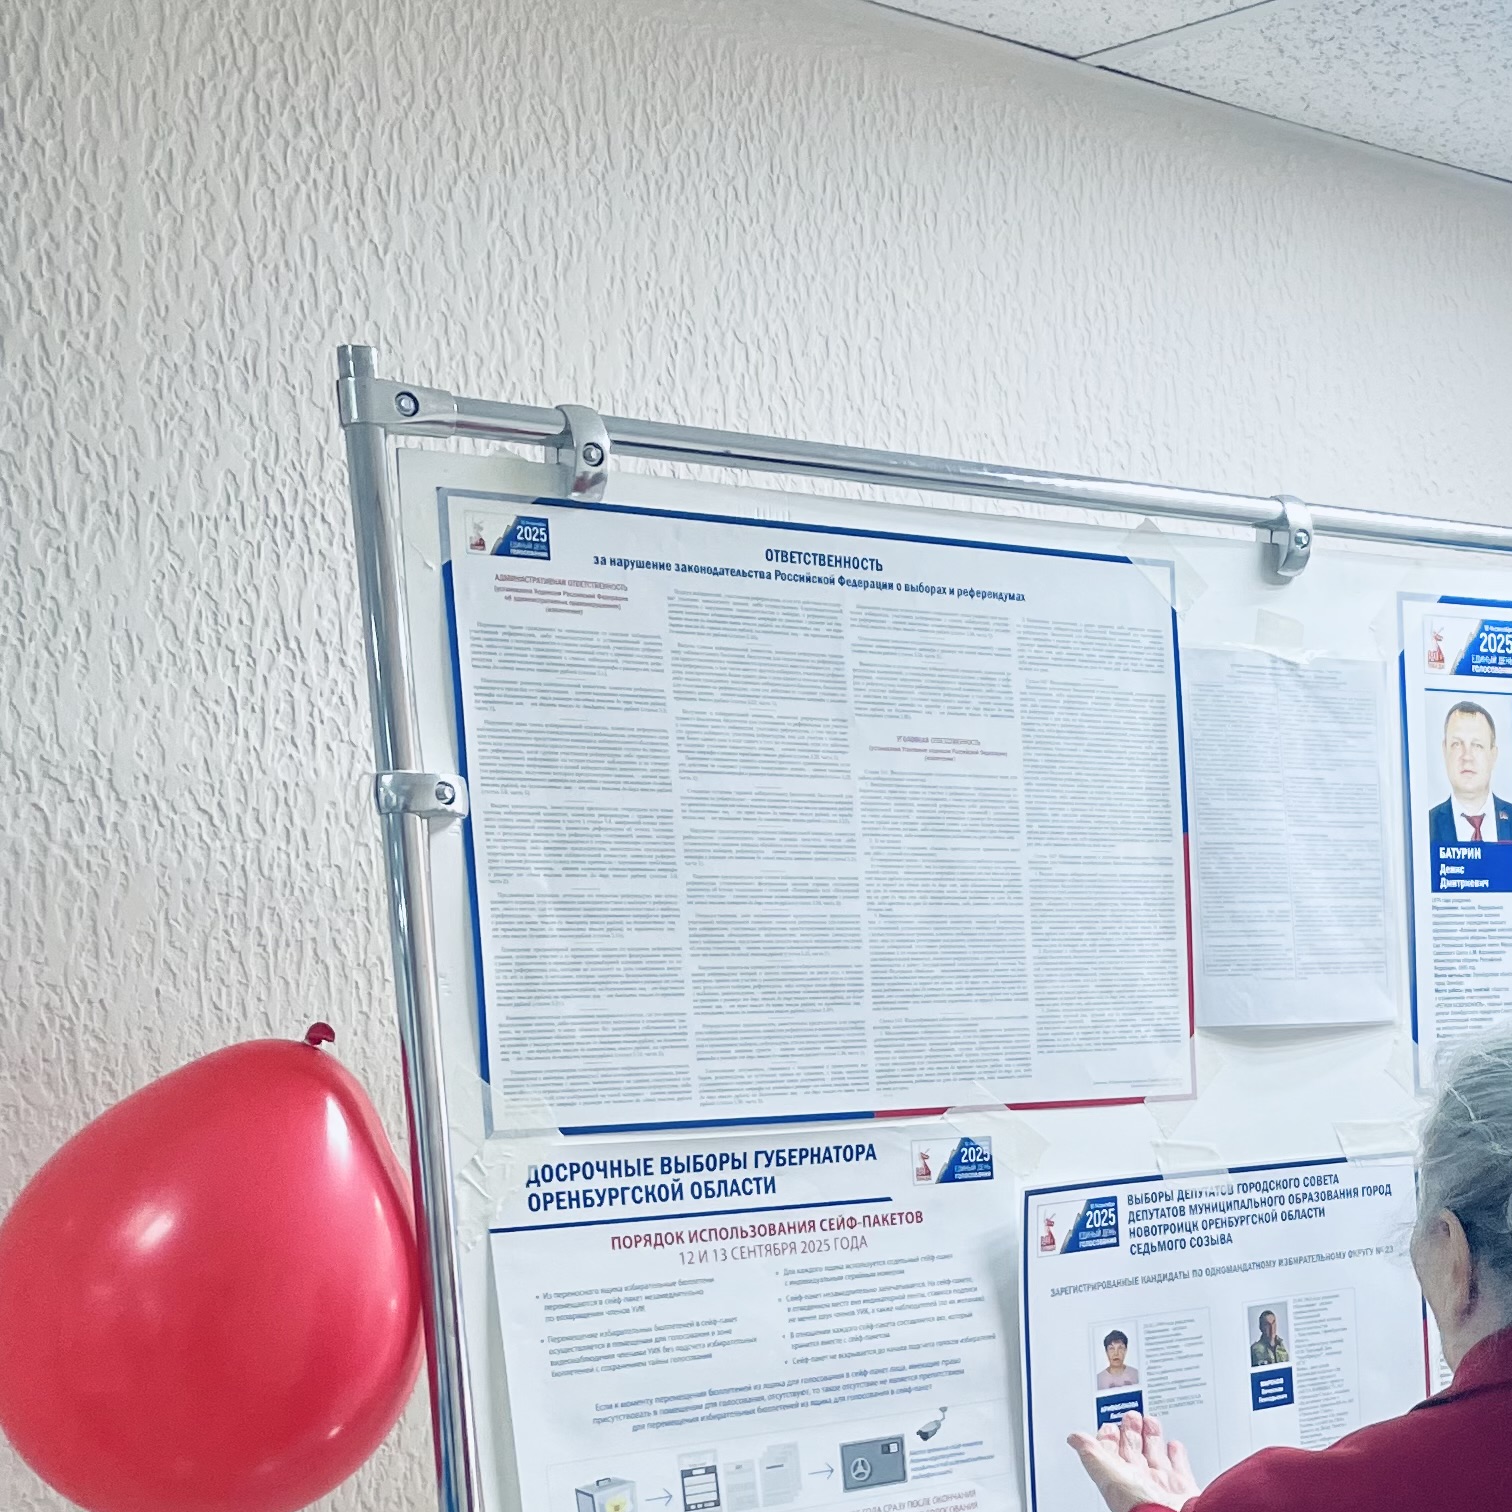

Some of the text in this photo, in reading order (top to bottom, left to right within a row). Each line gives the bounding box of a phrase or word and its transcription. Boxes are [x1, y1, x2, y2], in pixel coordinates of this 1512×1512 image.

[516, 525, 547, 543] 2025
[764, 548, 883, 571] ОТВЕТСТВЕННОСТЬ
[592, 554, 607, 566] за
[608, 557, 672, 571] нарушение
[673, 562, 772, 580] законодательства
[773, 568, 835, 585] Российской
[836, 574, 894, 591] Федерации
[895, 581, 902, 592] о
[903, 581, 947, 596] выборах
[956, 587, 1026, 602] референдумах
[1439, 846, 1482, 860] БАТУРИН
[524, 1143, 877, 1187] ДОСРОЧНЫЕ ВЫБОРЫ ГУБЕРНАТОРА
[960, 1146, 991, 1164] 2025
[526, 1175, 776, 1211] ОРЕНБУРГСКОЙ ОБЛАСТИ
[1126, 1189, 1174, 1206] ВЫБОРЫ
[1235, 1176, 1300, 1194] ГОРОДСКОГО
[1301, 1173, 1340, 1188] СОВЕТА
[1126, 1182, 1392, 1224] ДЕПУТАТОВ МУНИЦИПАЛЬНОГО ОБРАЗОВАНИЯ ГОРОД
[610, 1210, 924, 1250] ПОРЯДОК ИСПОЛЬЗОВАНИЯ СЕЙФ-ПАКЕТОВ
[1085, 1208, 1116, 1229] 2025
[1128, 1206, 1326, 1238] НОВОТРОИЦК ОРЕНБУРГСКОЙ ОБЛАСТИ
[678, 1234, 868, 1265] 12 И 13 СЕНТЯБРЯ 2025 ГОДА
[1128, 1232, 1233, 1256] СЕДЬМОГО СОЗЫВА
